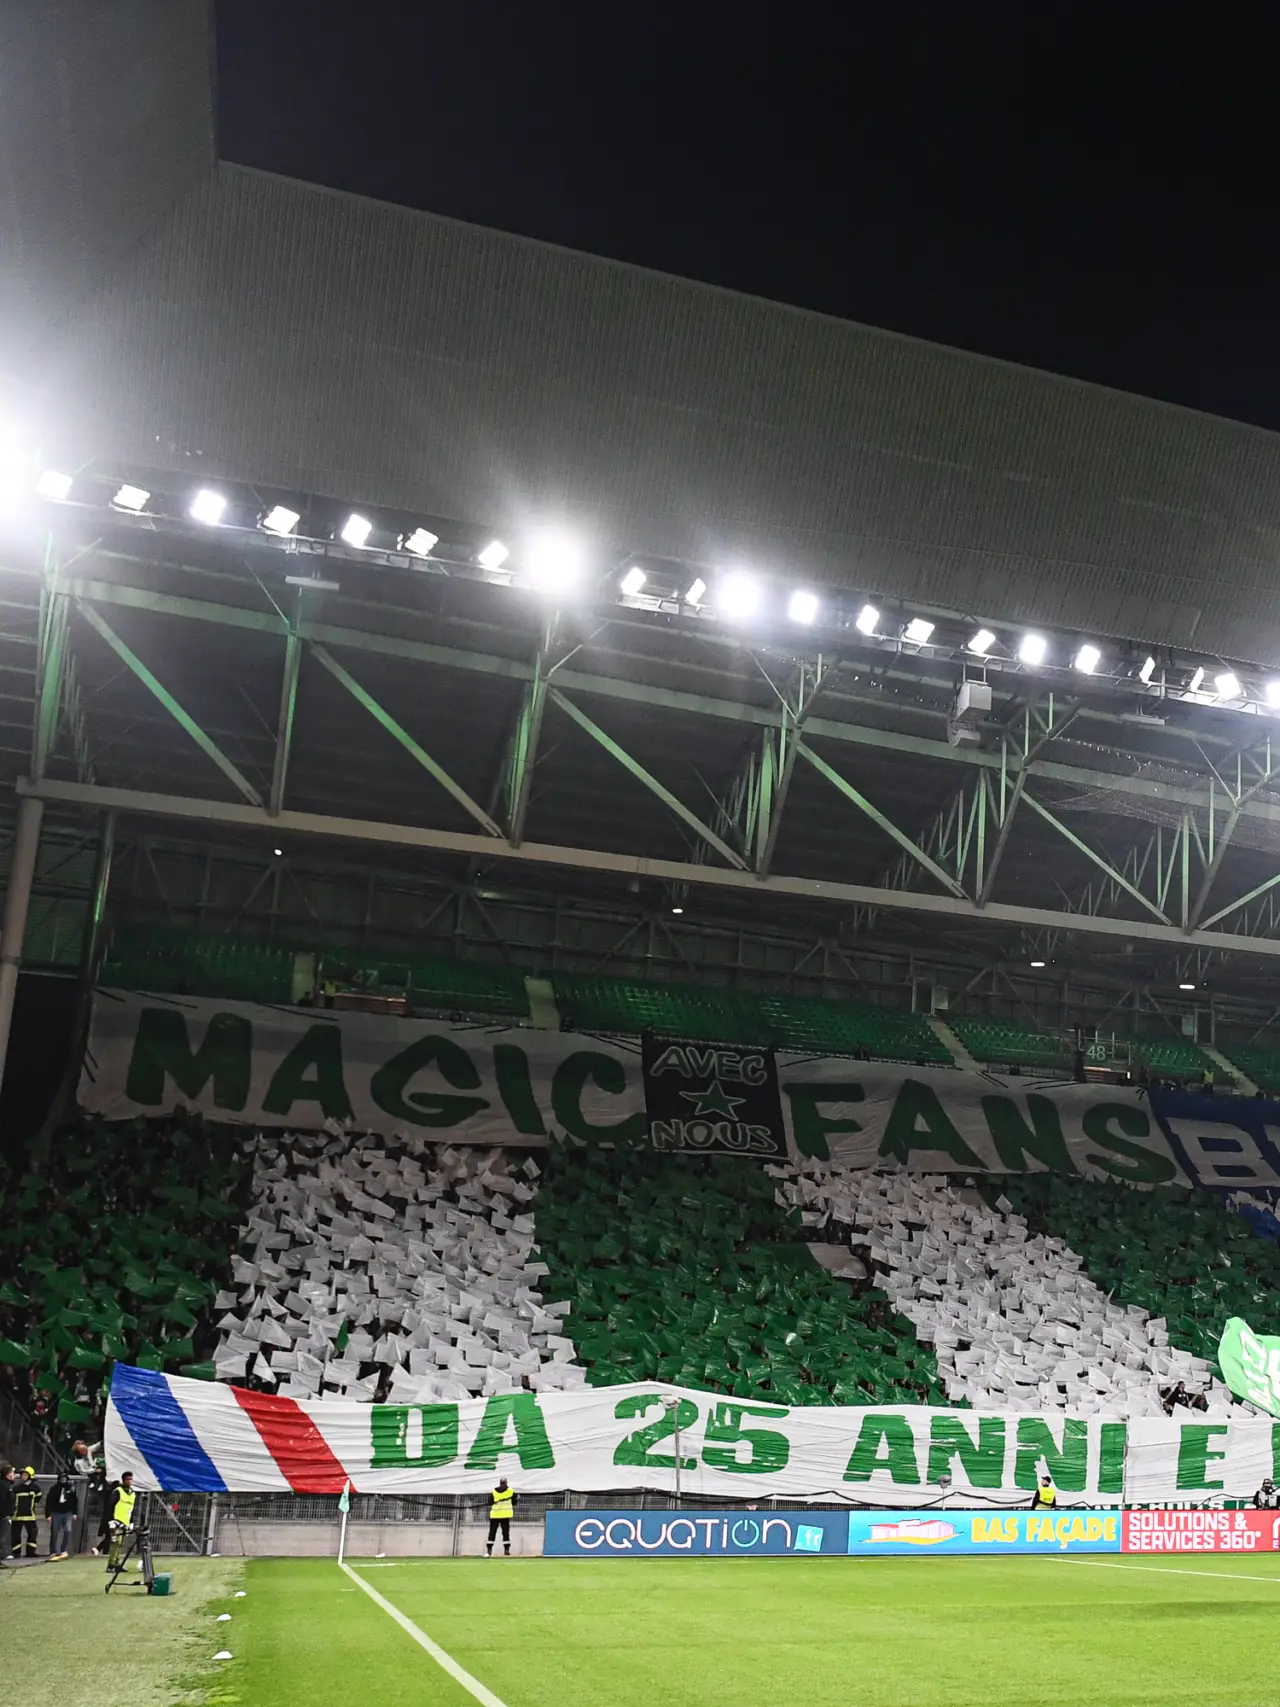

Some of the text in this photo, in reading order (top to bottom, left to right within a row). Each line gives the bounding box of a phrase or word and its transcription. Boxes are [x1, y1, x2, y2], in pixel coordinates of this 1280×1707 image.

[351, 969, 379, 987] 47
[650, 1046, 768, 1086] AVEC
[1086, 1045, 1106, 1061] 48
[125, 1007, 647, 1141] MAGIC
[651, 1119, 778, 1153] NOUS
[784, 1079, 1177, 1183] FANS
[370, 1393, 556, 1471] DA
[613, 1393, 791, 1474] 25
[843, 1413, 1126, 1494] ANNI
[1176, 1424, 1228, 1490] E
[971, 1517, 1117, 1549] BAS FAÇADE
[1128, 1512, 1248, 1531] SOLUTIONS &
[1128, 1531, 1215, 1550] SERVICES
